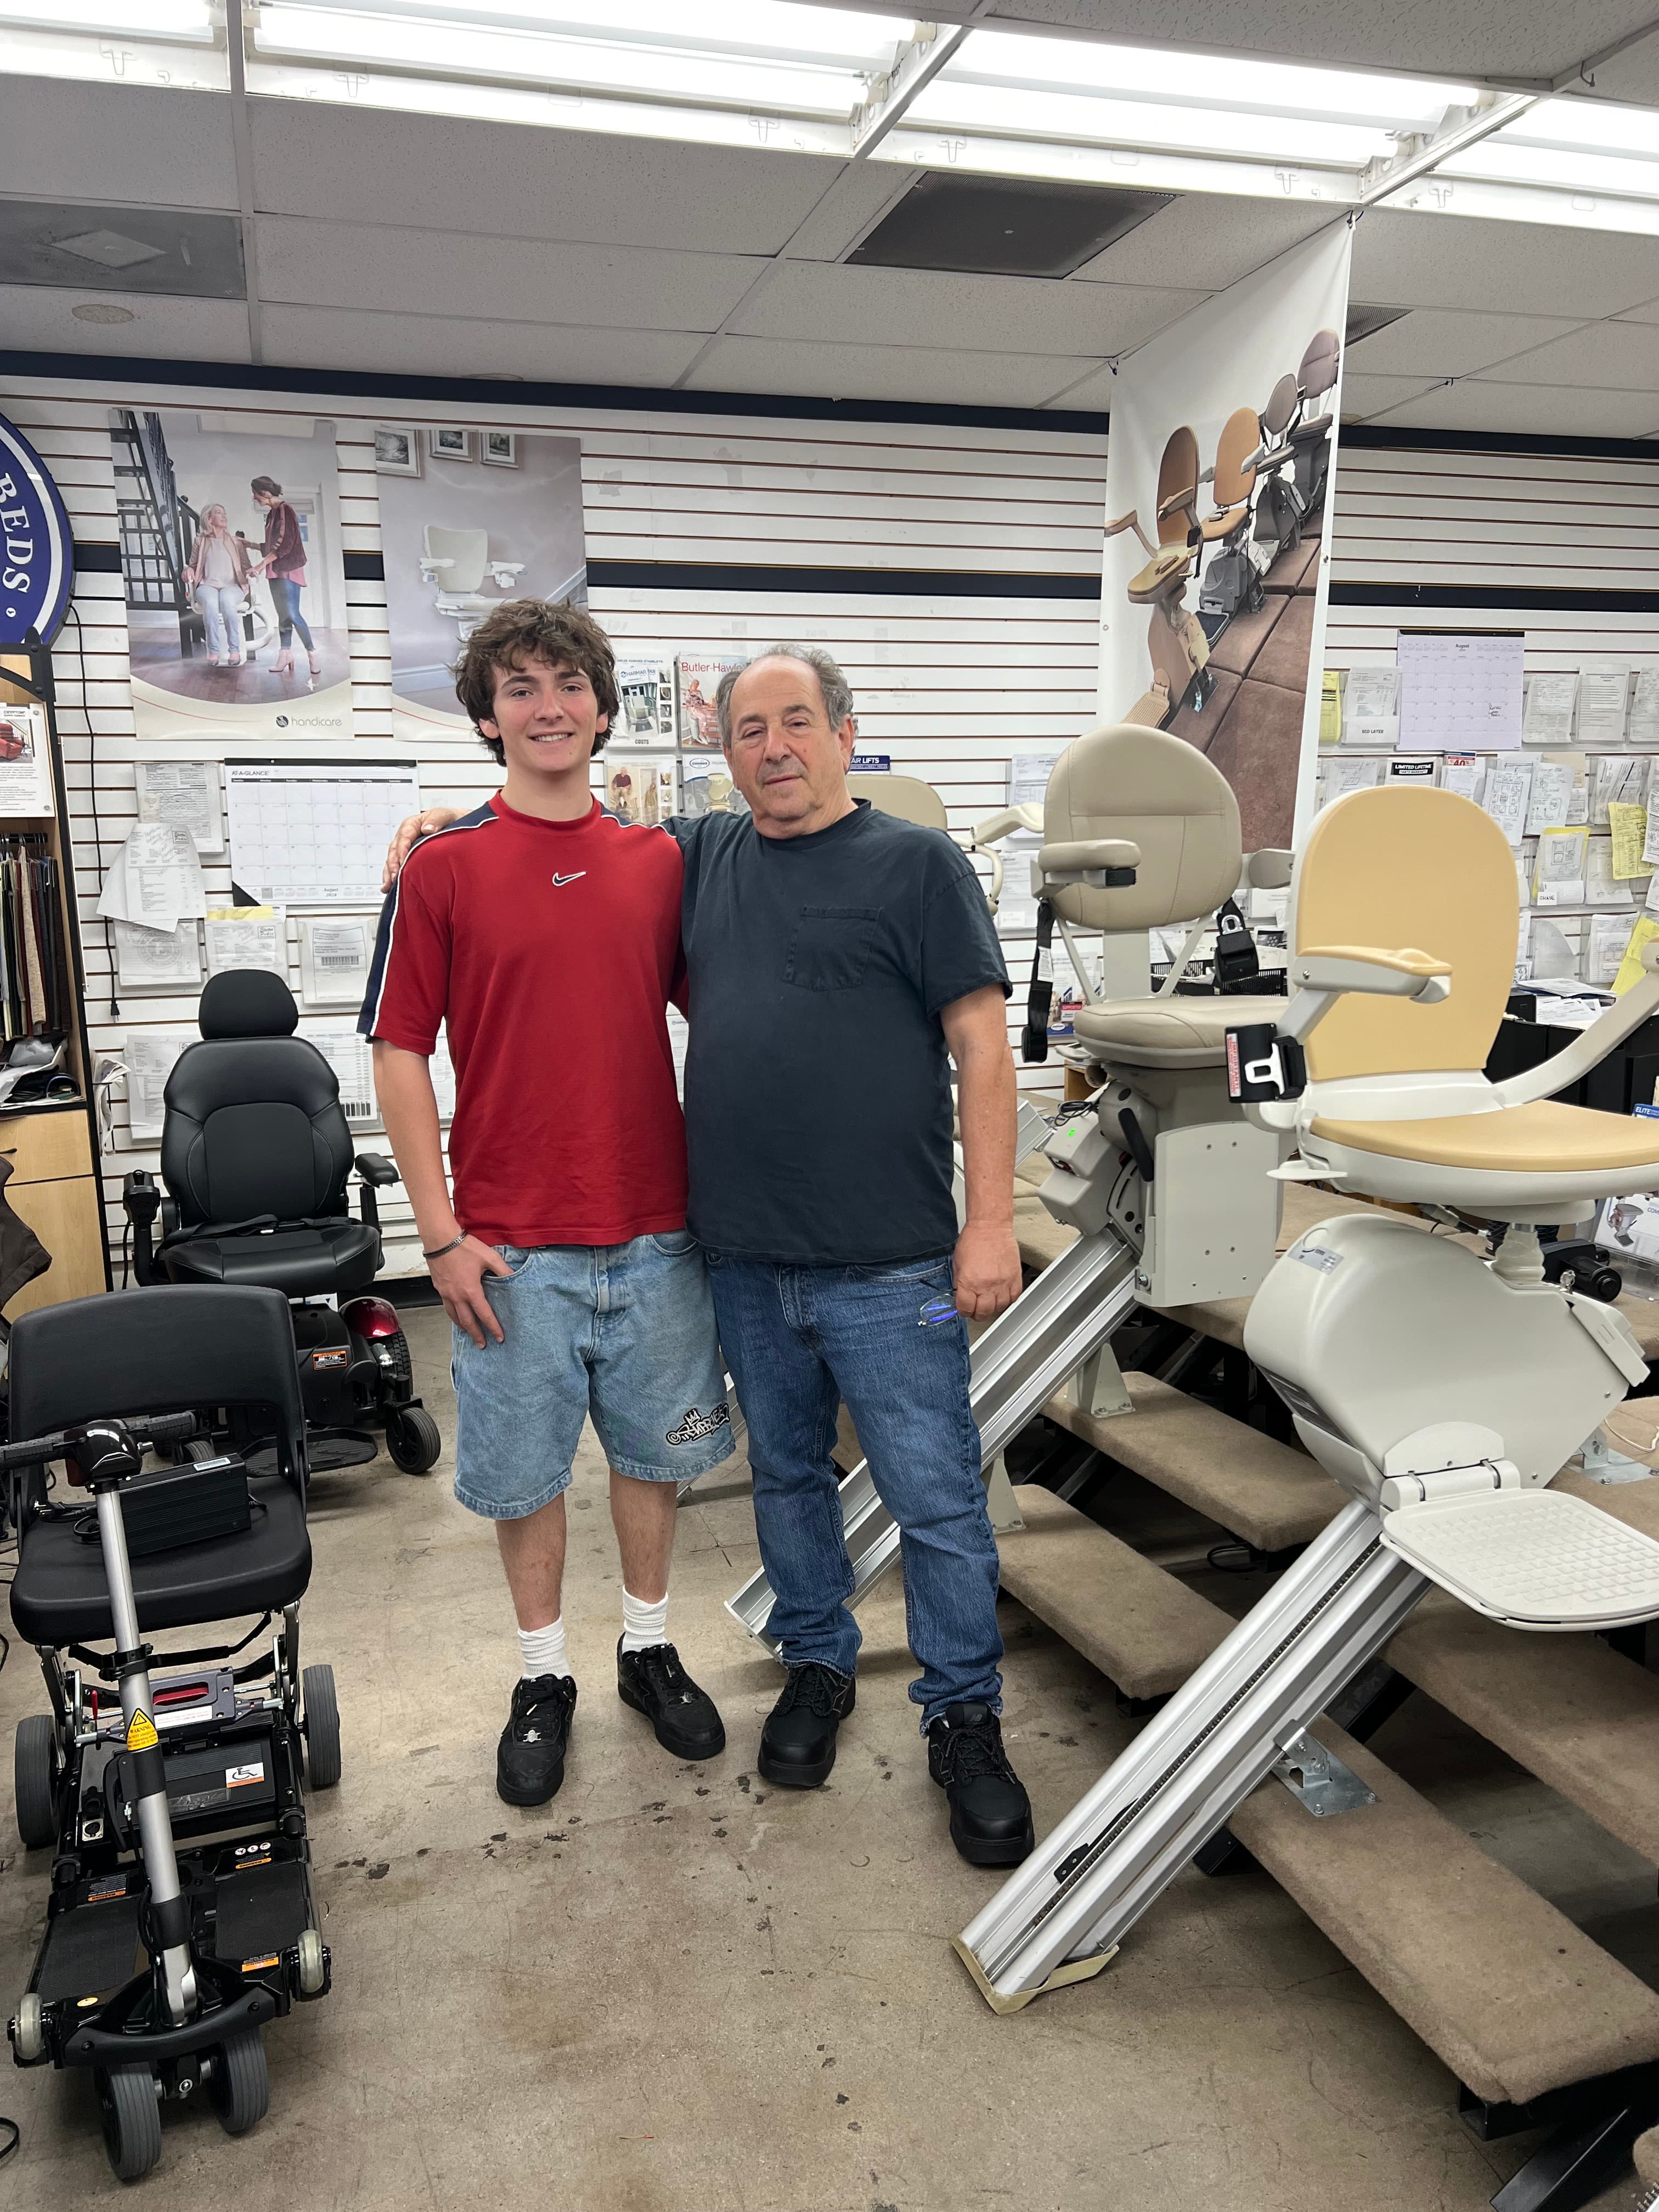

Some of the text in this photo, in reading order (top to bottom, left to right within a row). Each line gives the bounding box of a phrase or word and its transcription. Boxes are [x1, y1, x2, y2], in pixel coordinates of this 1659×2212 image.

[0, 472, 33, 593] BEDS
[291, 716, 342, 726] handicare
[1635, 1106, 1651, 1115] ELITE
[130, 1725, 151, 1734] WARNING
